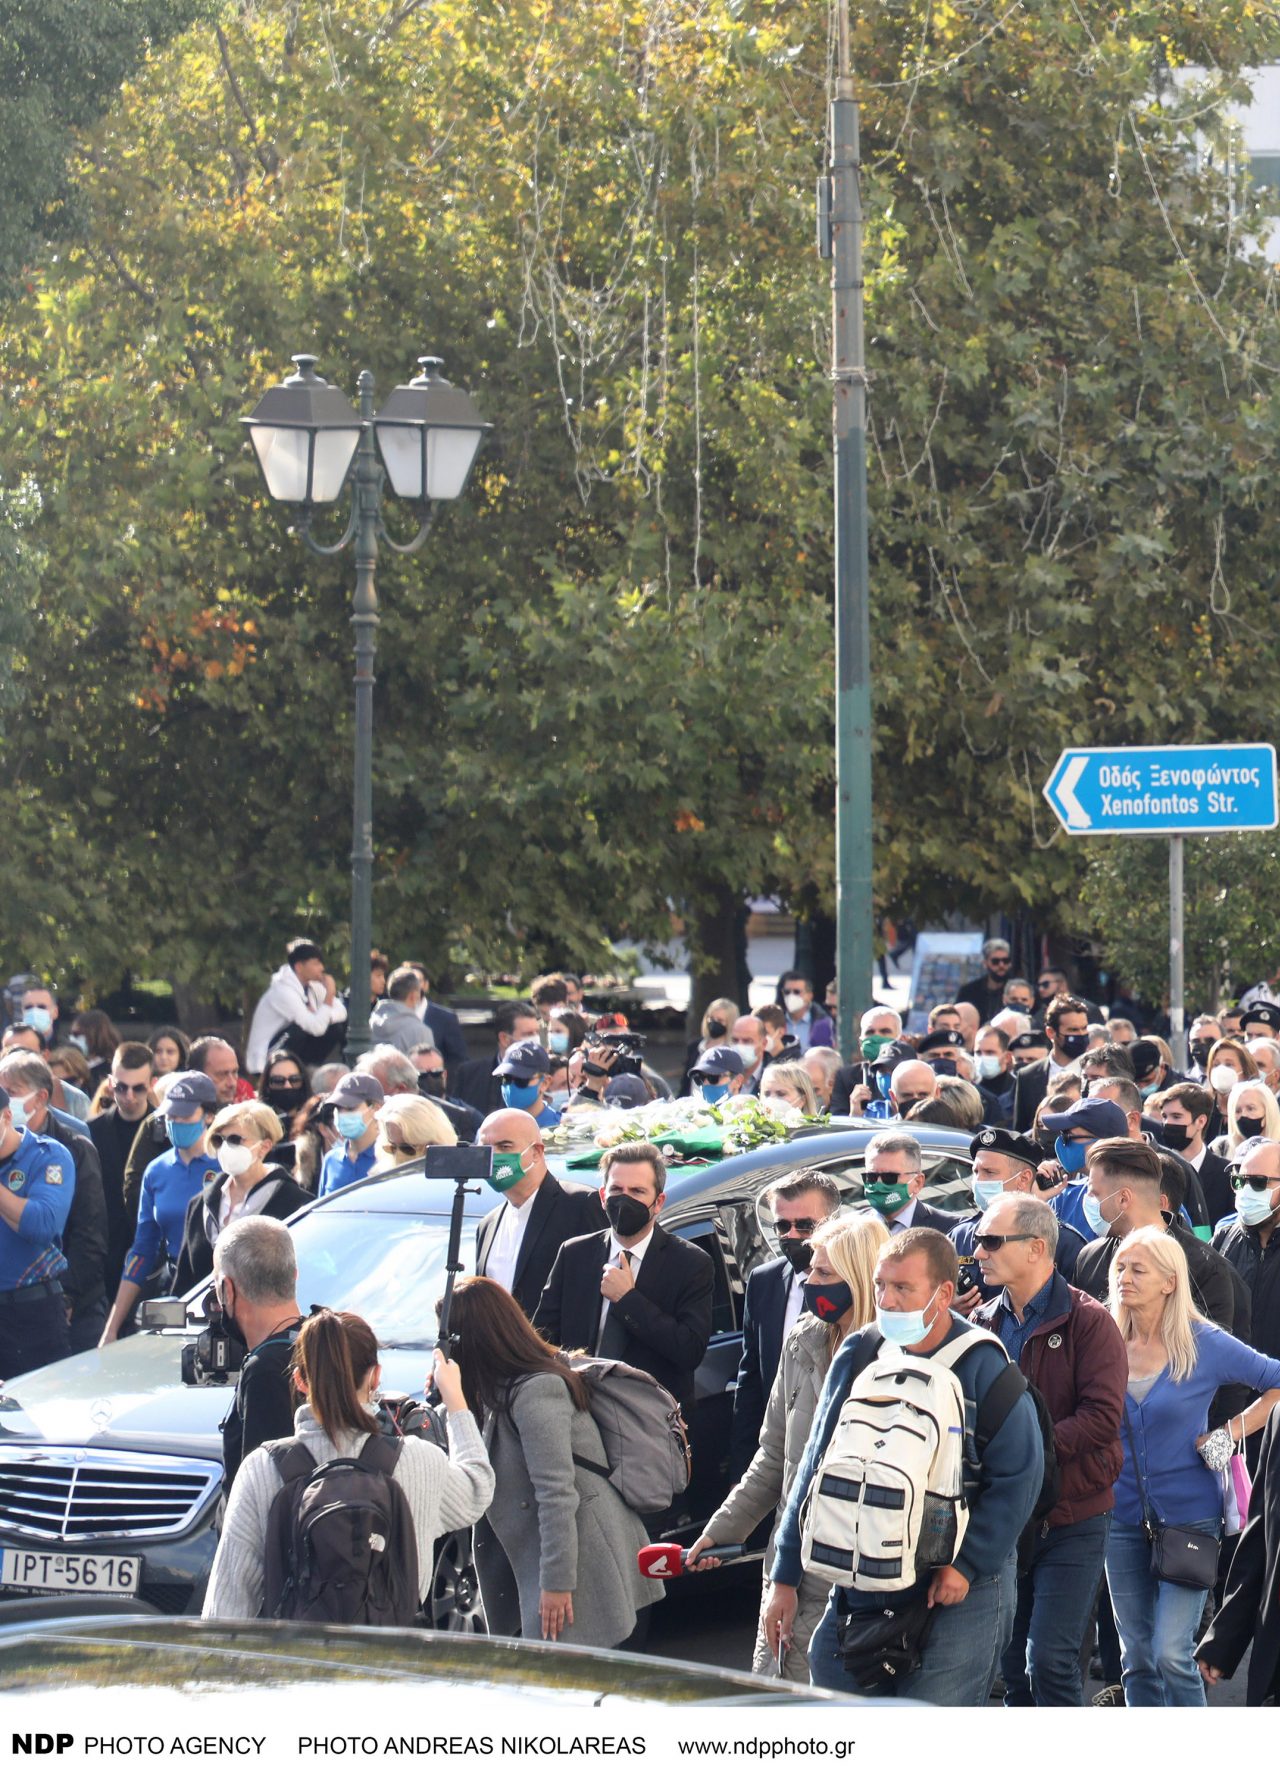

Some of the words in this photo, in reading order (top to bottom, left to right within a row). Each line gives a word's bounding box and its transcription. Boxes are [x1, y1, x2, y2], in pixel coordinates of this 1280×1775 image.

[1099, 765, 1141, 791] Οδός
[1150, 763, 1260, 791] Ξενοφώντος
[1101, 794, 1199, 816] Xenofontos
[1207, 792, 1238, 813] Str.
